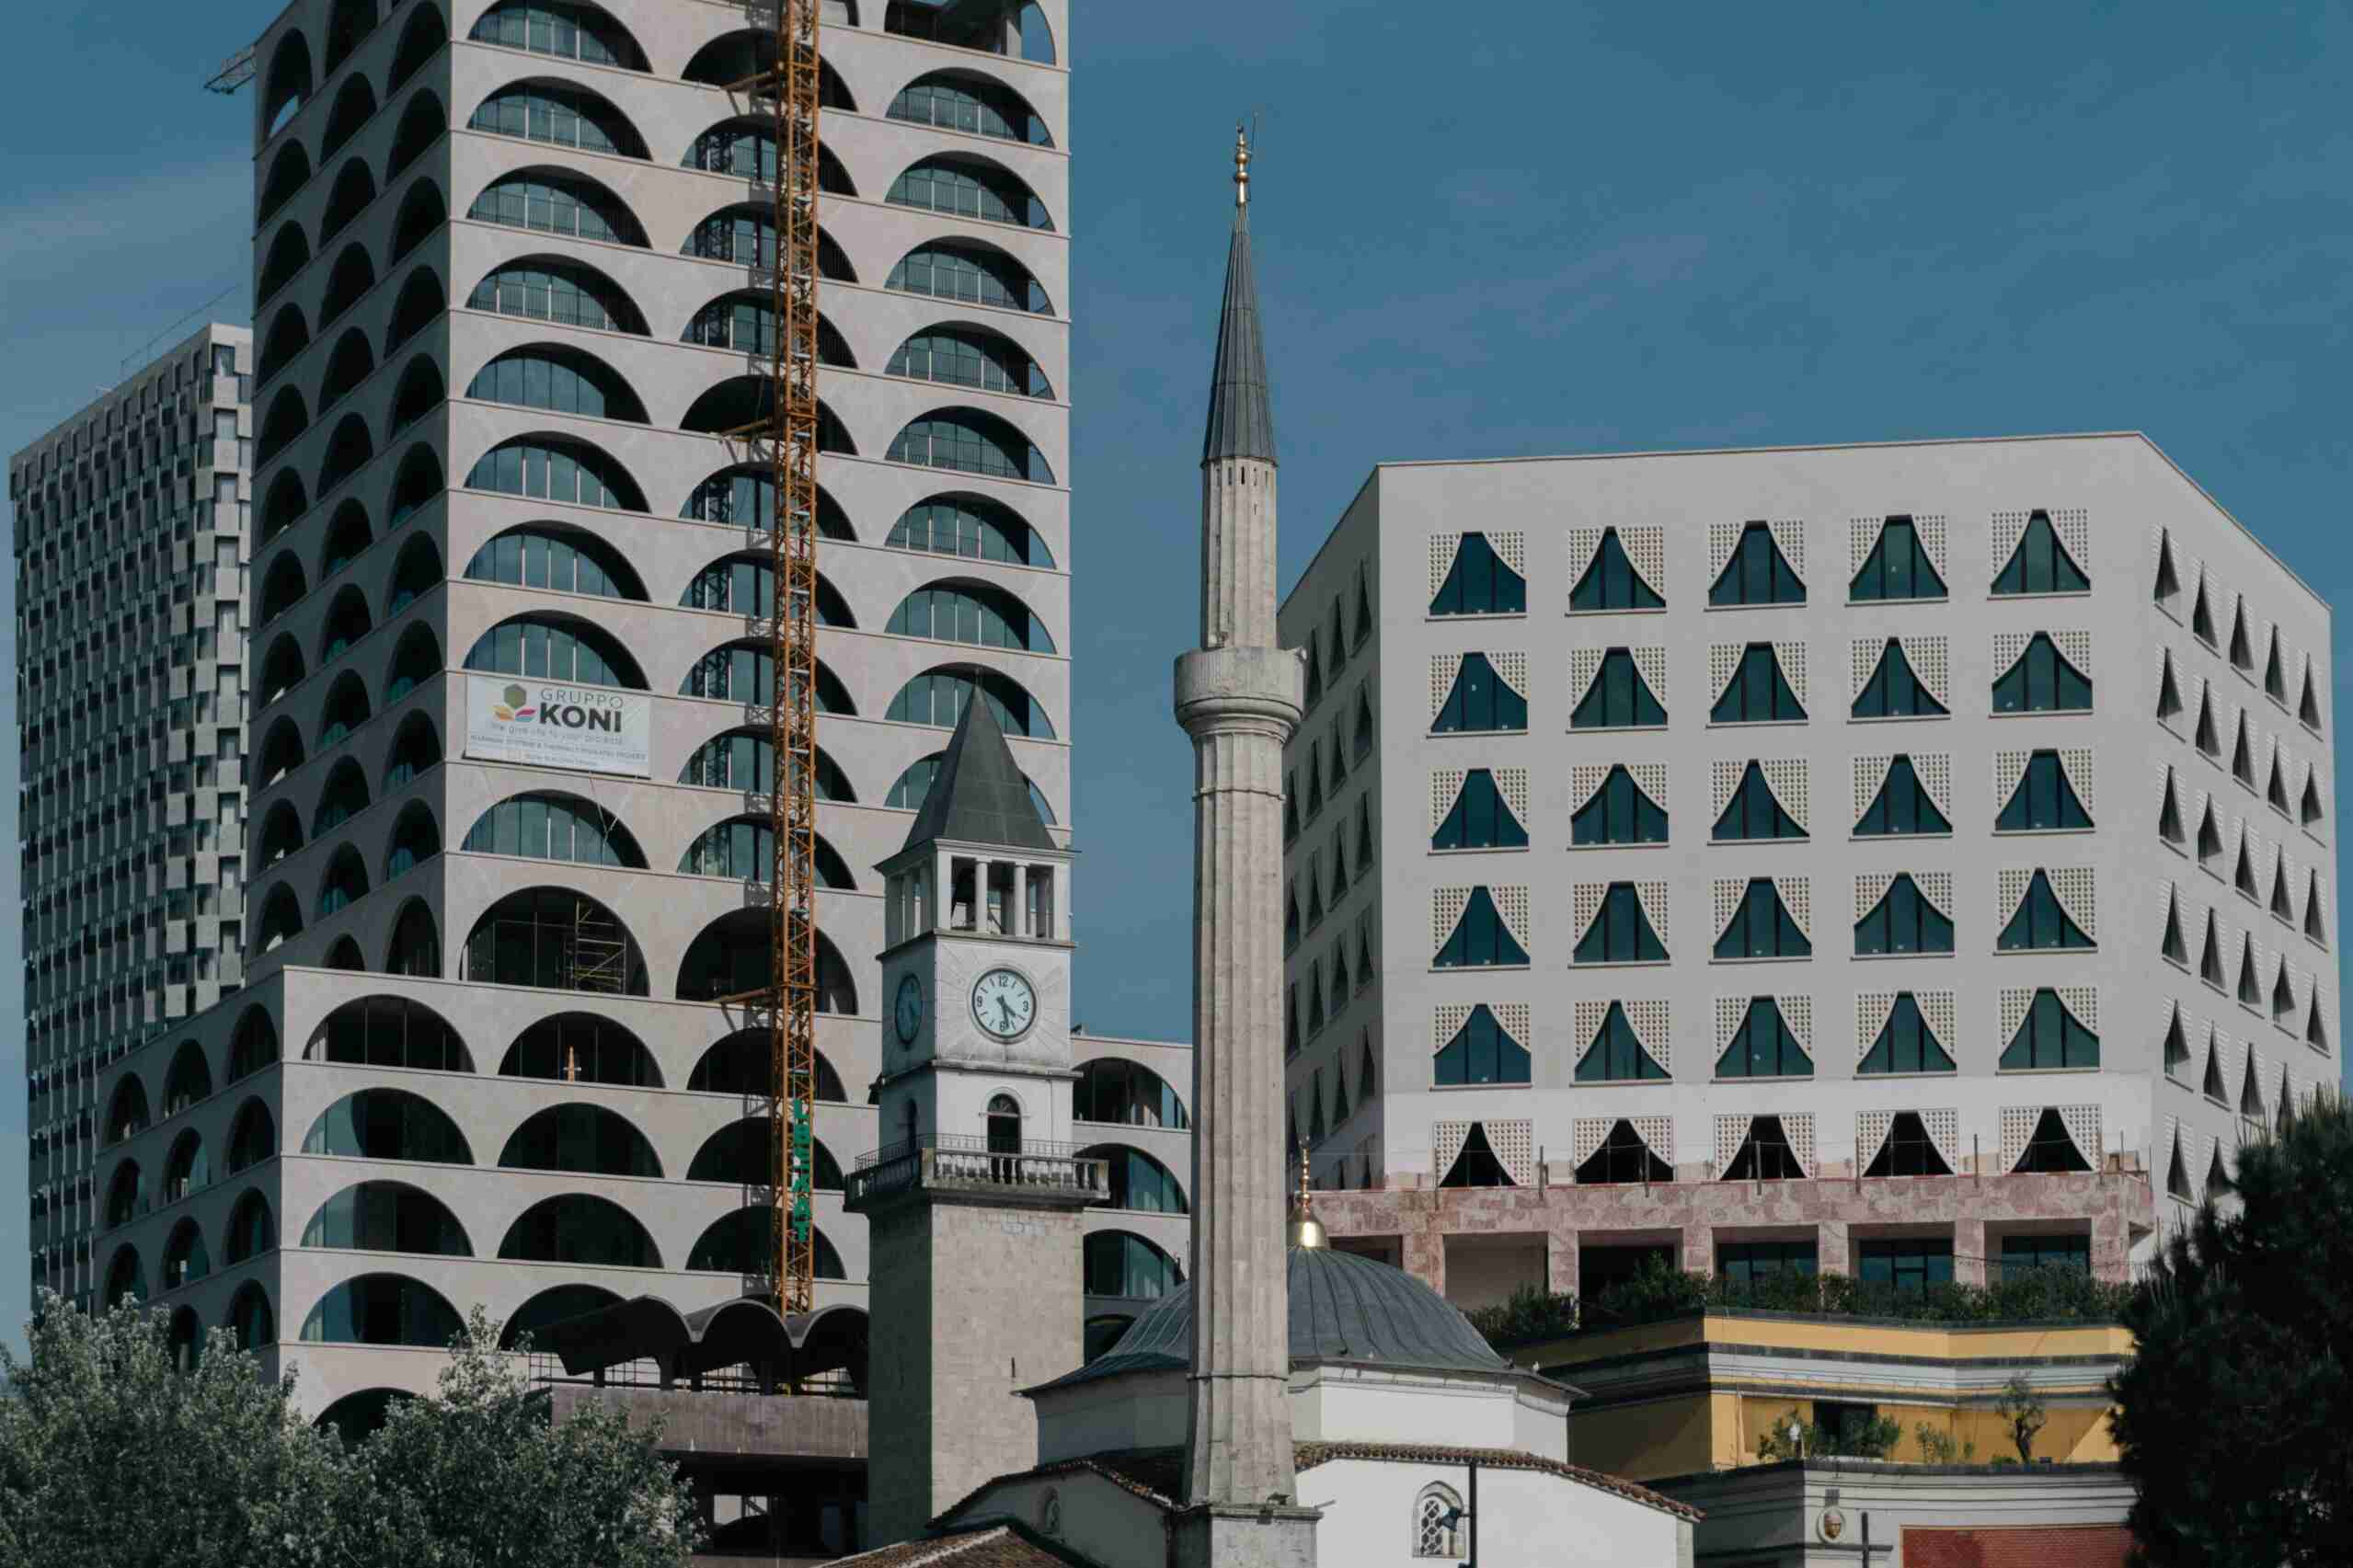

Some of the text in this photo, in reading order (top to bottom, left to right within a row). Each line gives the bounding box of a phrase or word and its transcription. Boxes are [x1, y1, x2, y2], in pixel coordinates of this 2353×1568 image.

[540, 688, 624, 710] GRUPPO
[539, 702, 623, 733] KONI
[998, 975, 1009, 988] 12
[977, 995, 983, 1008] 9
[1022, 1000, 1029, 1013] 3
